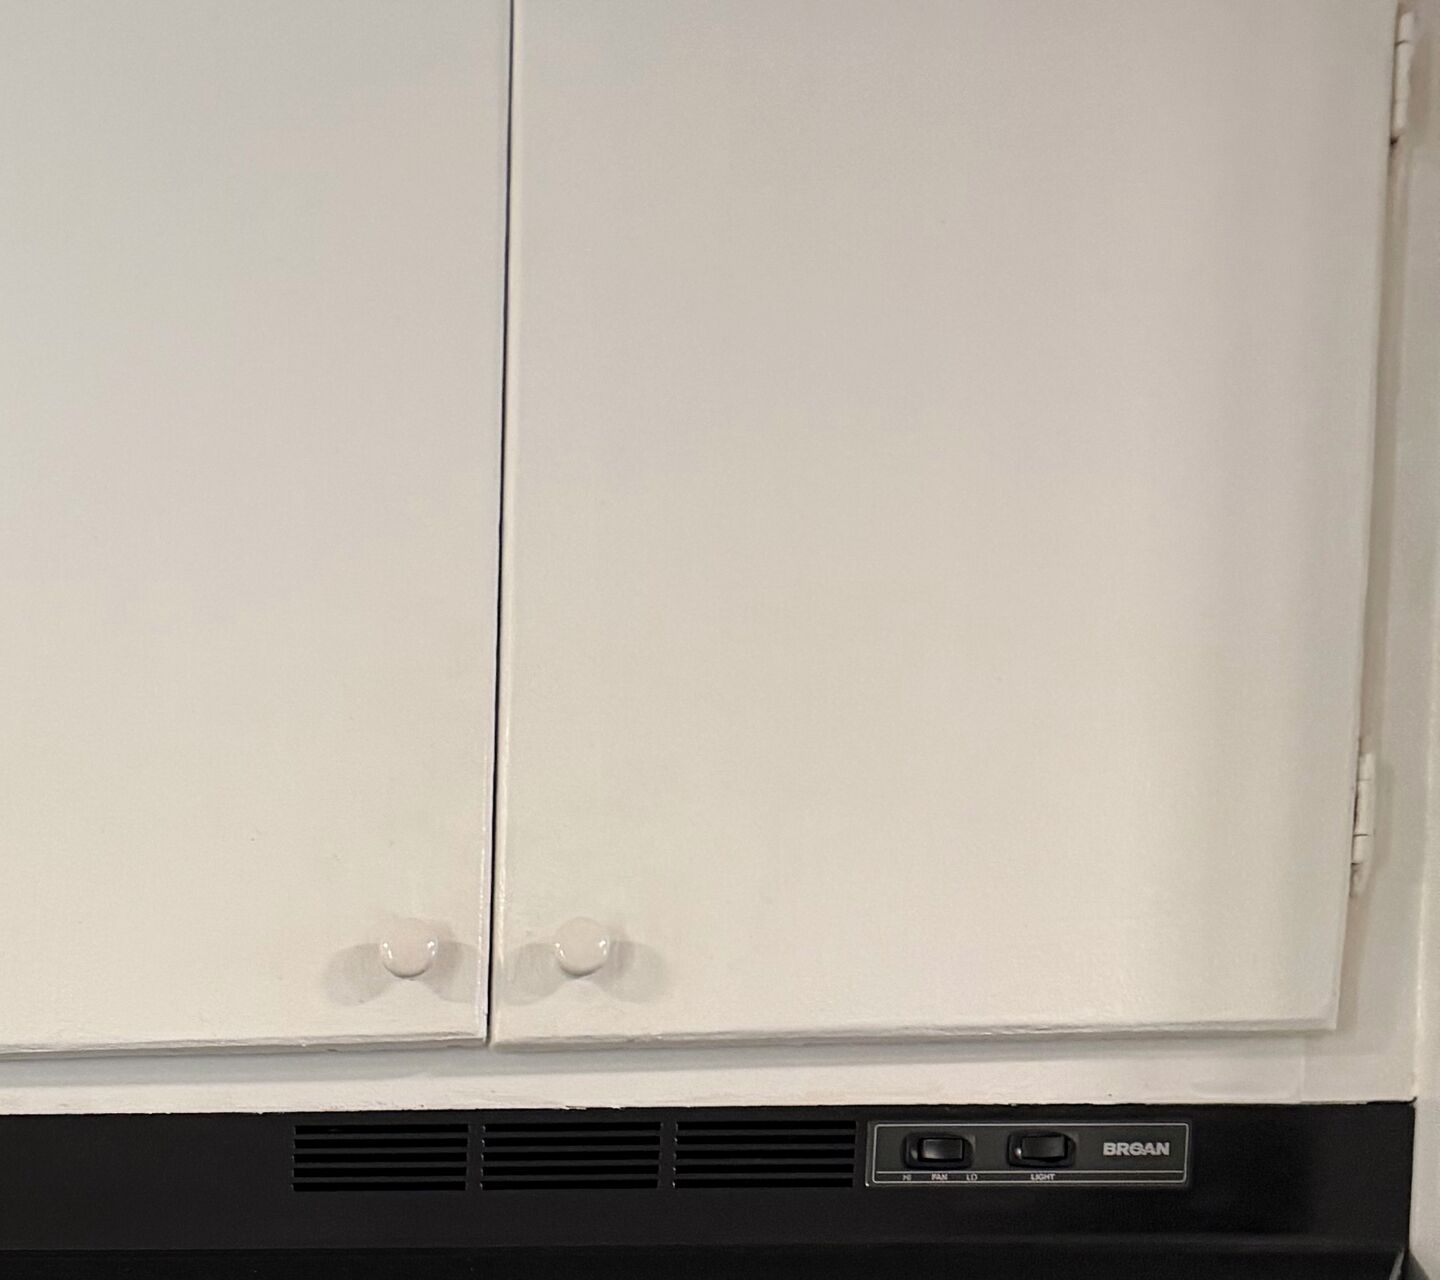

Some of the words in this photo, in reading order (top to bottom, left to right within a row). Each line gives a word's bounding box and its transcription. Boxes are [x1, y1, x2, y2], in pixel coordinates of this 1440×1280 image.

[1103, 1142, 1169, 1156] BROAN
[931, 1173, 948, 1181] FAN
[1030, 1173, 1056, 1182] LIGHT
